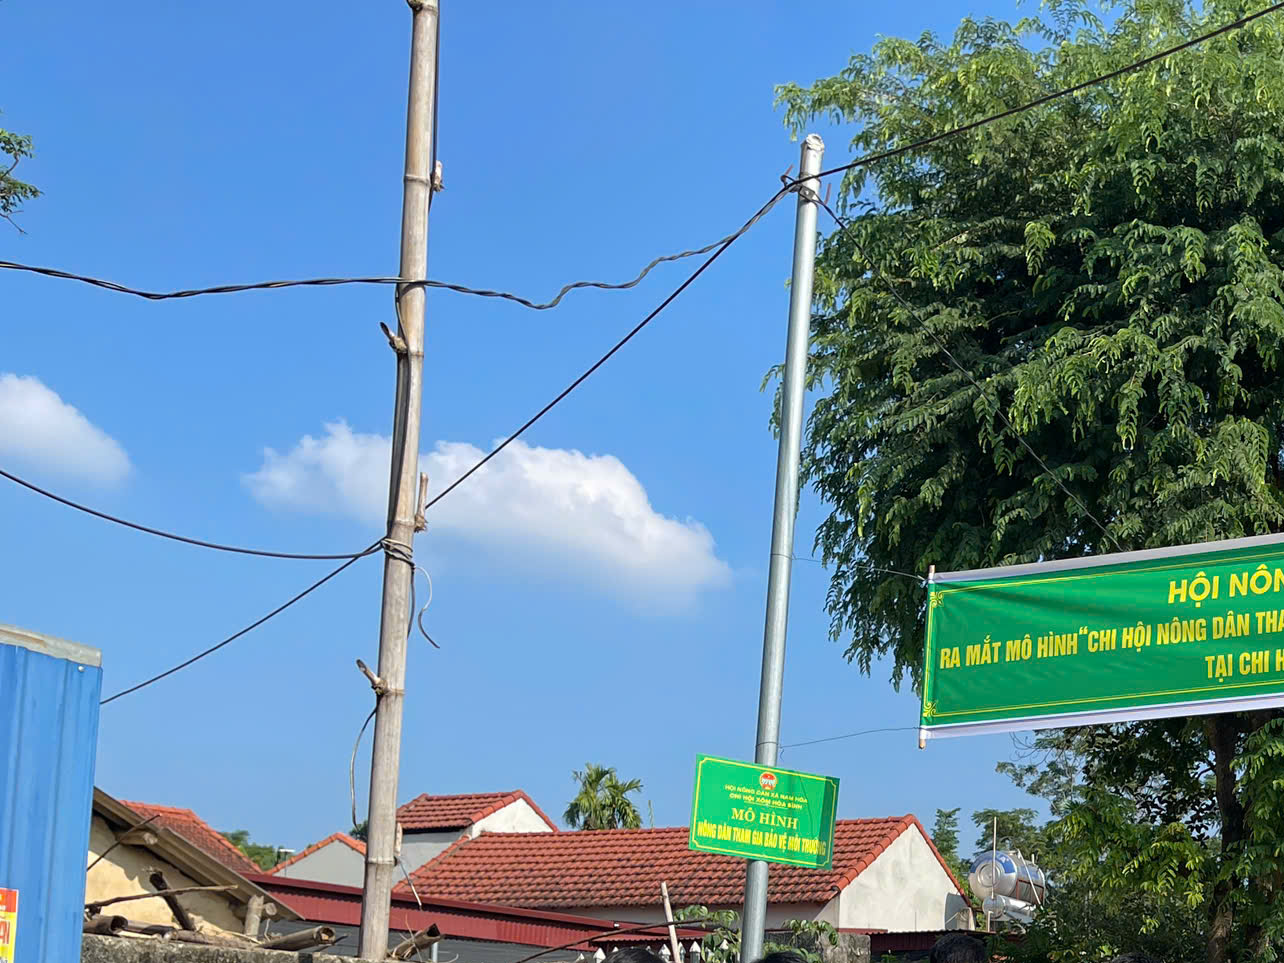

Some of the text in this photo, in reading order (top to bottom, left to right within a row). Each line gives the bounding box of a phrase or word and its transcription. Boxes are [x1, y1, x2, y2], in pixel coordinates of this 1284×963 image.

[1168, 571, 1219, 607] HỘI
[940, 646, 961, 669] RA
[965, 634, 1000, 666] MẮT
[1005, 633, 1032, 663] MÔ
[1121, 620, 1151, 652] HỘI
[1156, 615, 1206, 645] NÔNG
[1212, 610, 1249, 639] DÂN
[1205, 654, 1233, 683] TẠI
[1239, 652, 1269, 676] CHI
[731, 807, 799, 829] MÔ HÌNH
[717, 822, 732, 840] DÂN
[733, 826, 751, 845] THAM
[752, 830, 762, 846] GIA
[764, 828, 778, 848] BẢO
